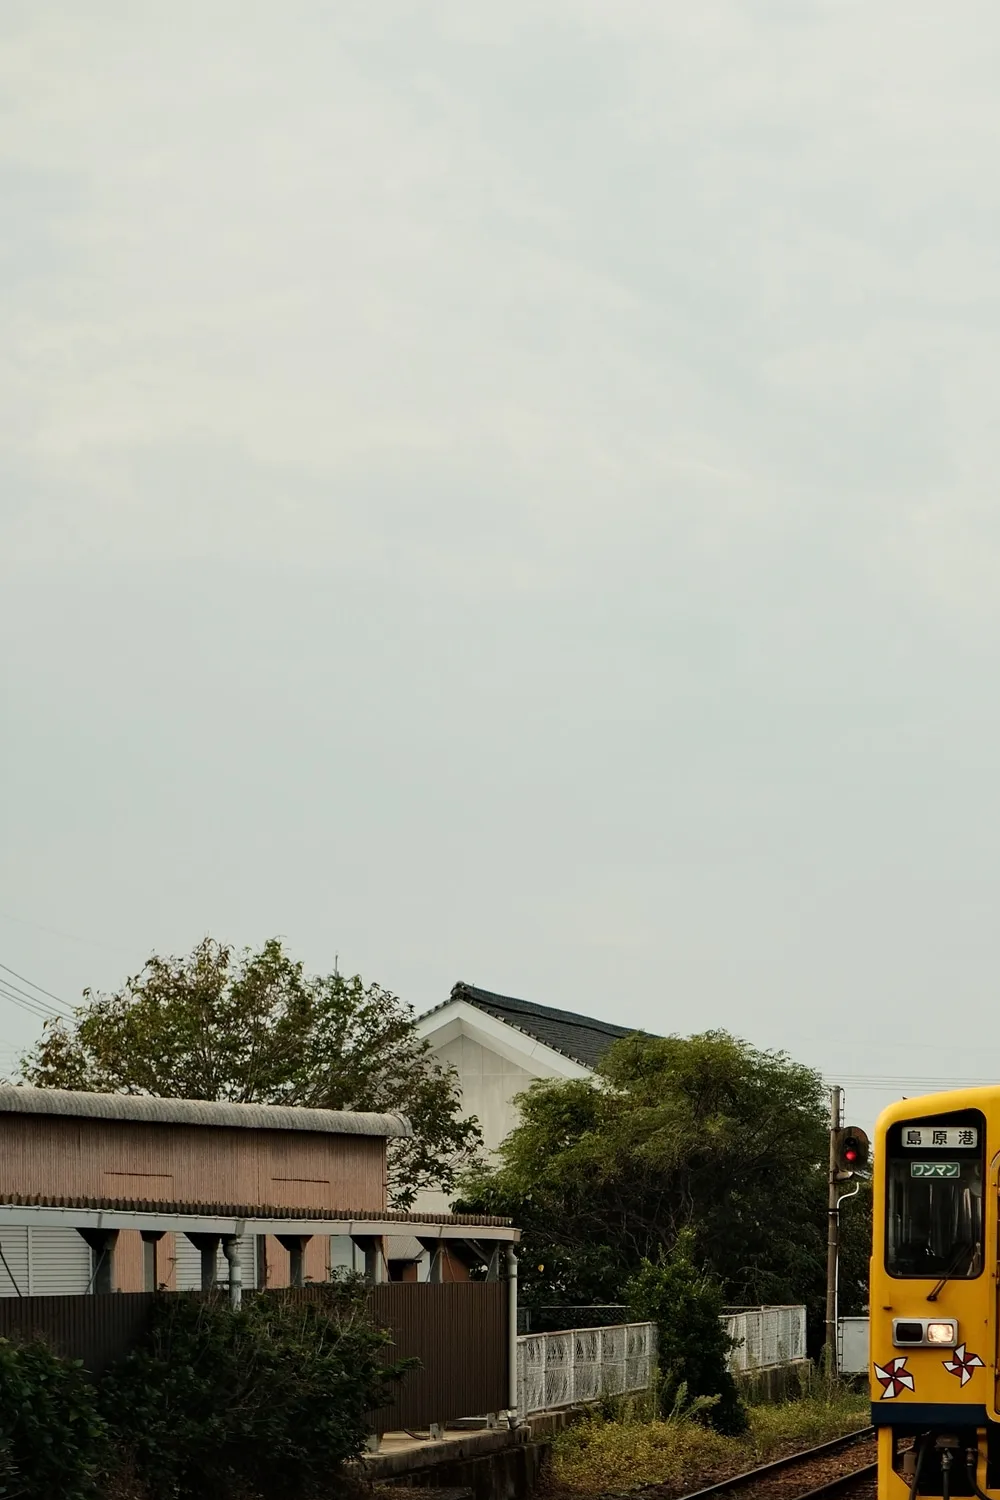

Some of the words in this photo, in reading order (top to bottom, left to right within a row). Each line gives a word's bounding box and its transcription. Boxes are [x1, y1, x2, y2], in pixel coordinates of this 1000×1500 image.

[907, 1130, 974, 1146] 島原港
[913, 1164, 957, 1176] ワンマン
